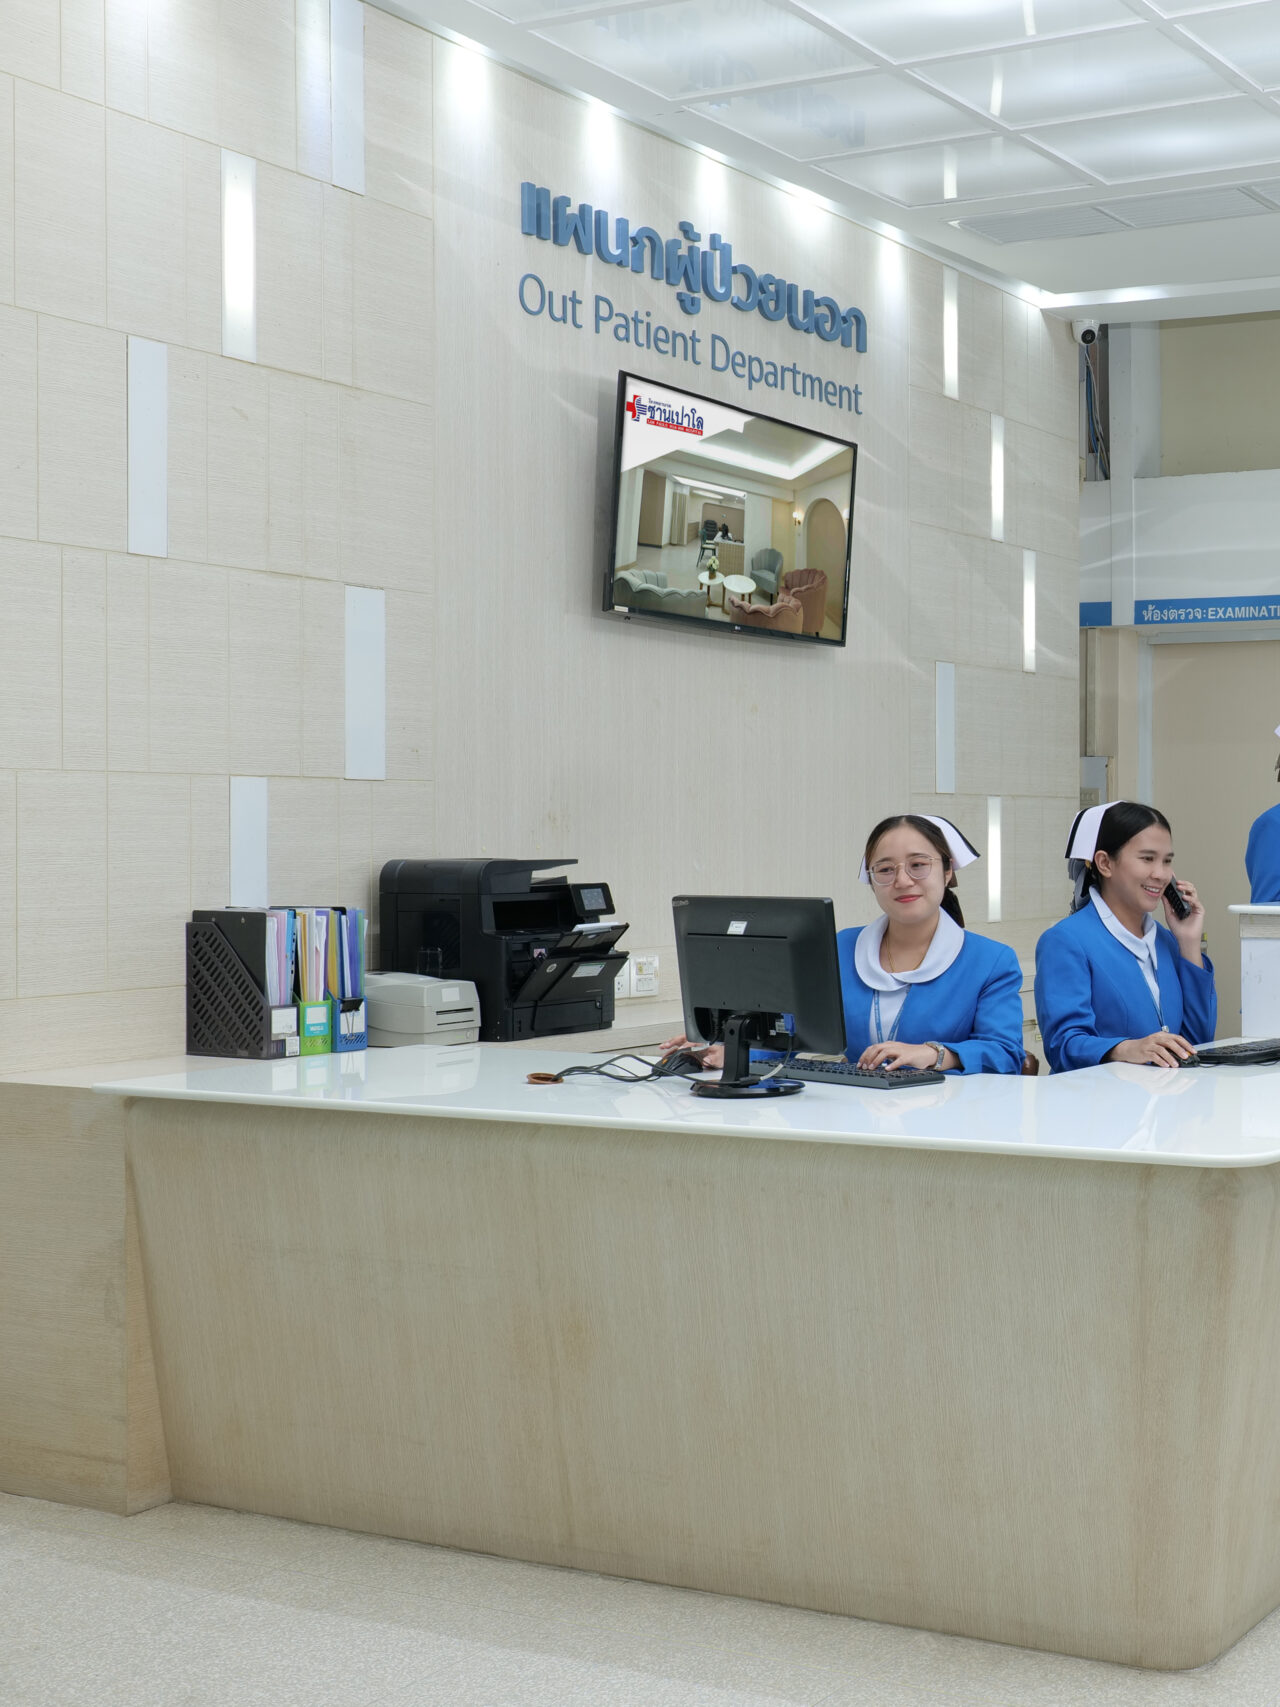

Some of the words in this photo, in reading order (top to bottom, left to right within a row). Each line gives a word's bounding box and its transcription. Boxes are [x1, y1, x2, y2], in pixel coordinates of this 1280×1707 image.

[518, 273, 583, 329] Out
[594, 294, 701, 365] Patient
[711, 333, 863, 415] Department
[521, 182, 868, 353] แผนกผู้ป่วยนอก
